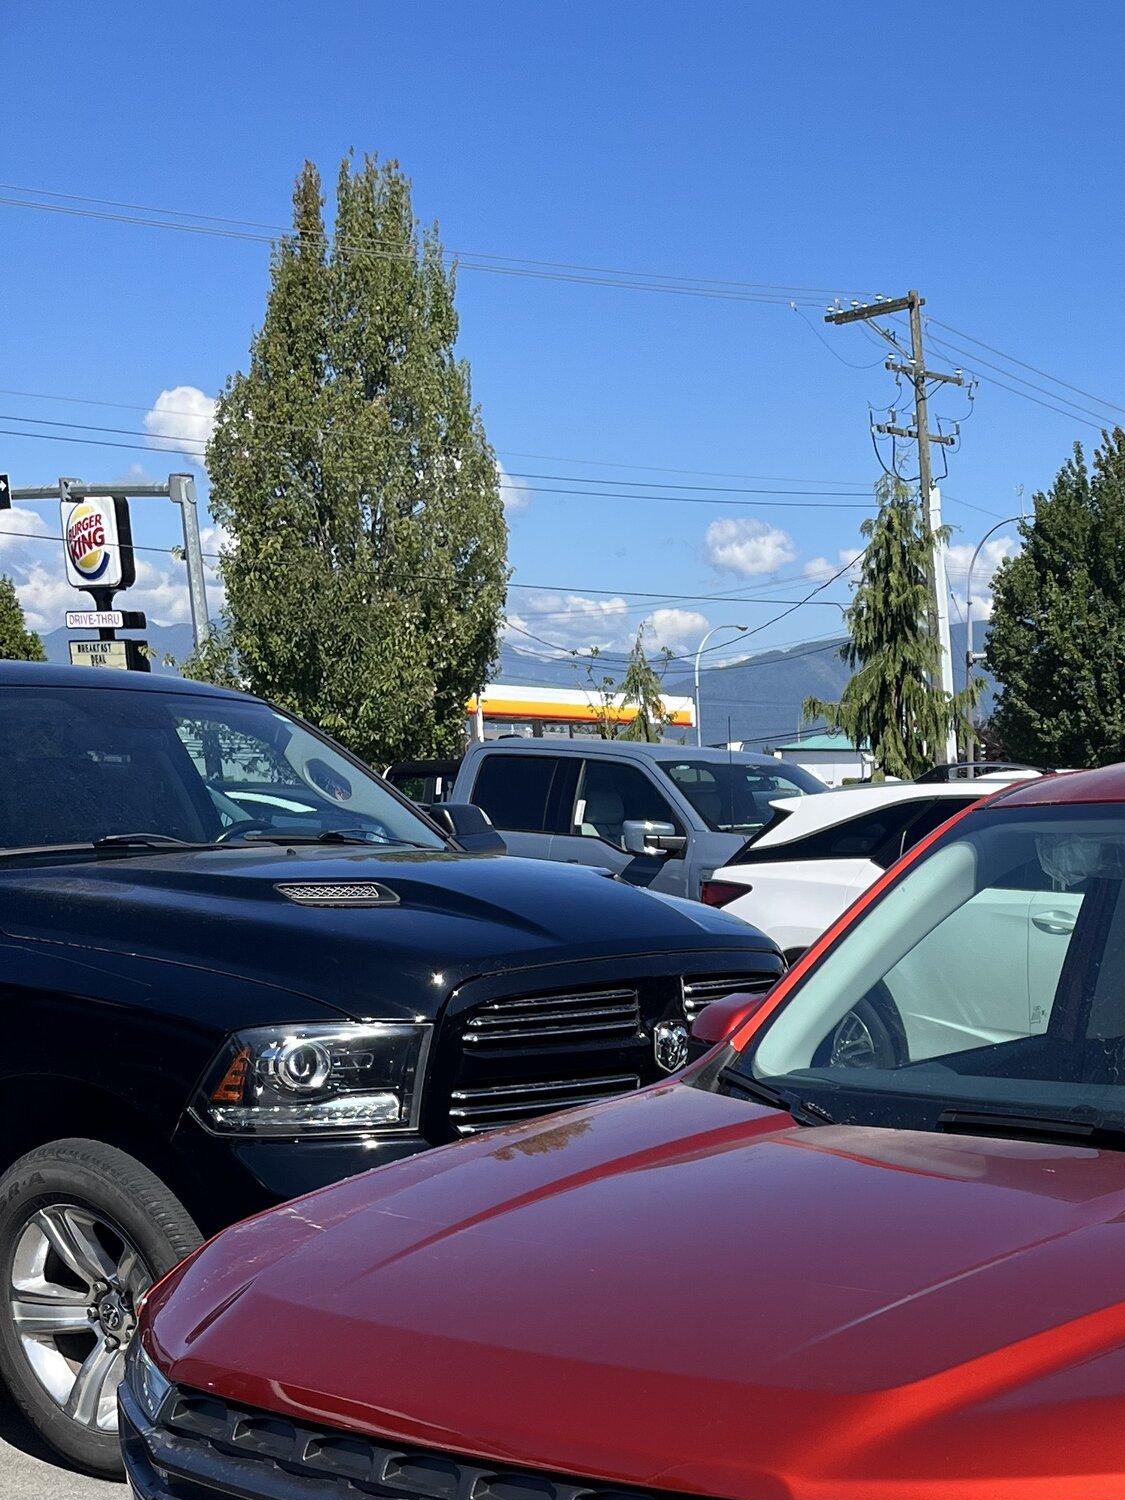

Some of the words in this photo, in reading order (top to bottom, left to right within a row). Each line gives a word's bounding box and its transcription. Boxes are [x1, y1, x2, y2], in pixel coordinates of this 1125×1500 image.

[68, 513, 103, 539] BURGER
[70, 527, 106, 561] KING
[69, 614, 120, 625] DRIVE-THRU
